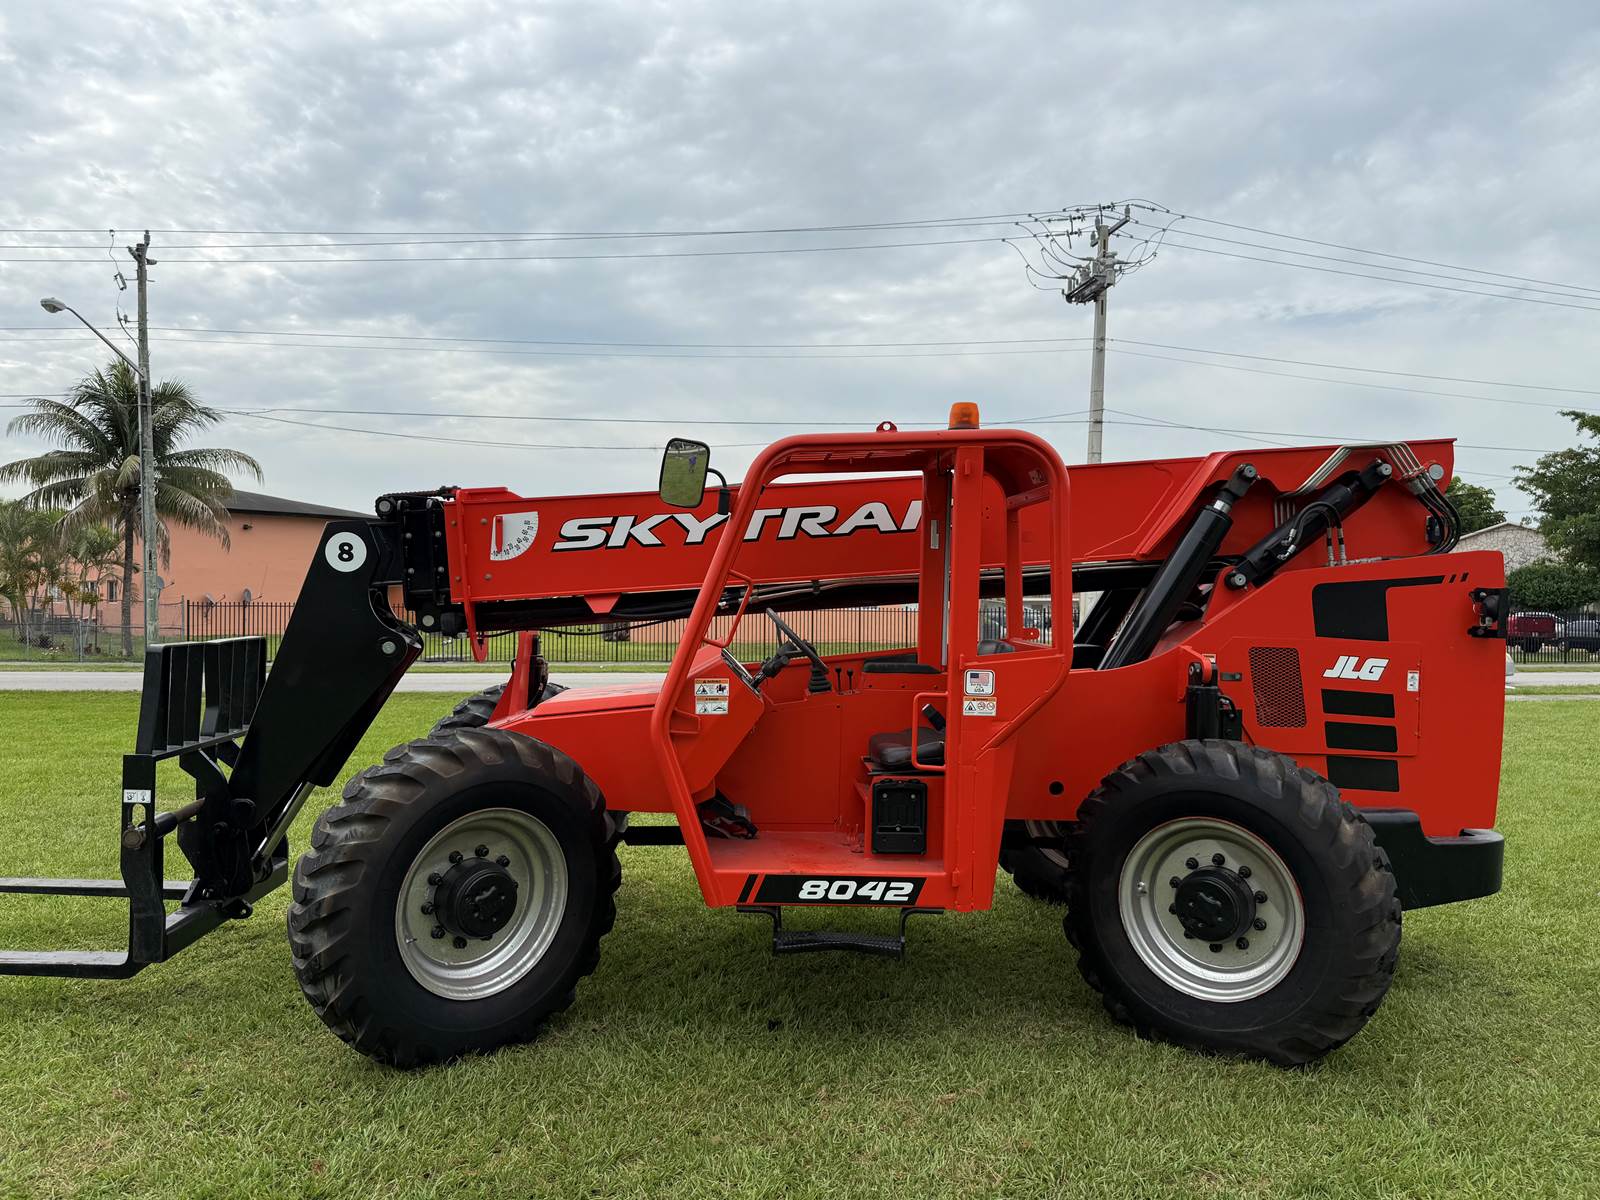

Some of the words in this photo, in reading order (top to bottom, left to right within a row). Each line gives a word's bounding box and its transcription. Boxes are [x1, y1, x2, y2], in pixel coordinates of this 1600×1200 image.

[337, 541, 354, 563] 8
[1322, 655, 1390, 681] JLG
[797, 880, 915, 901] 8042
